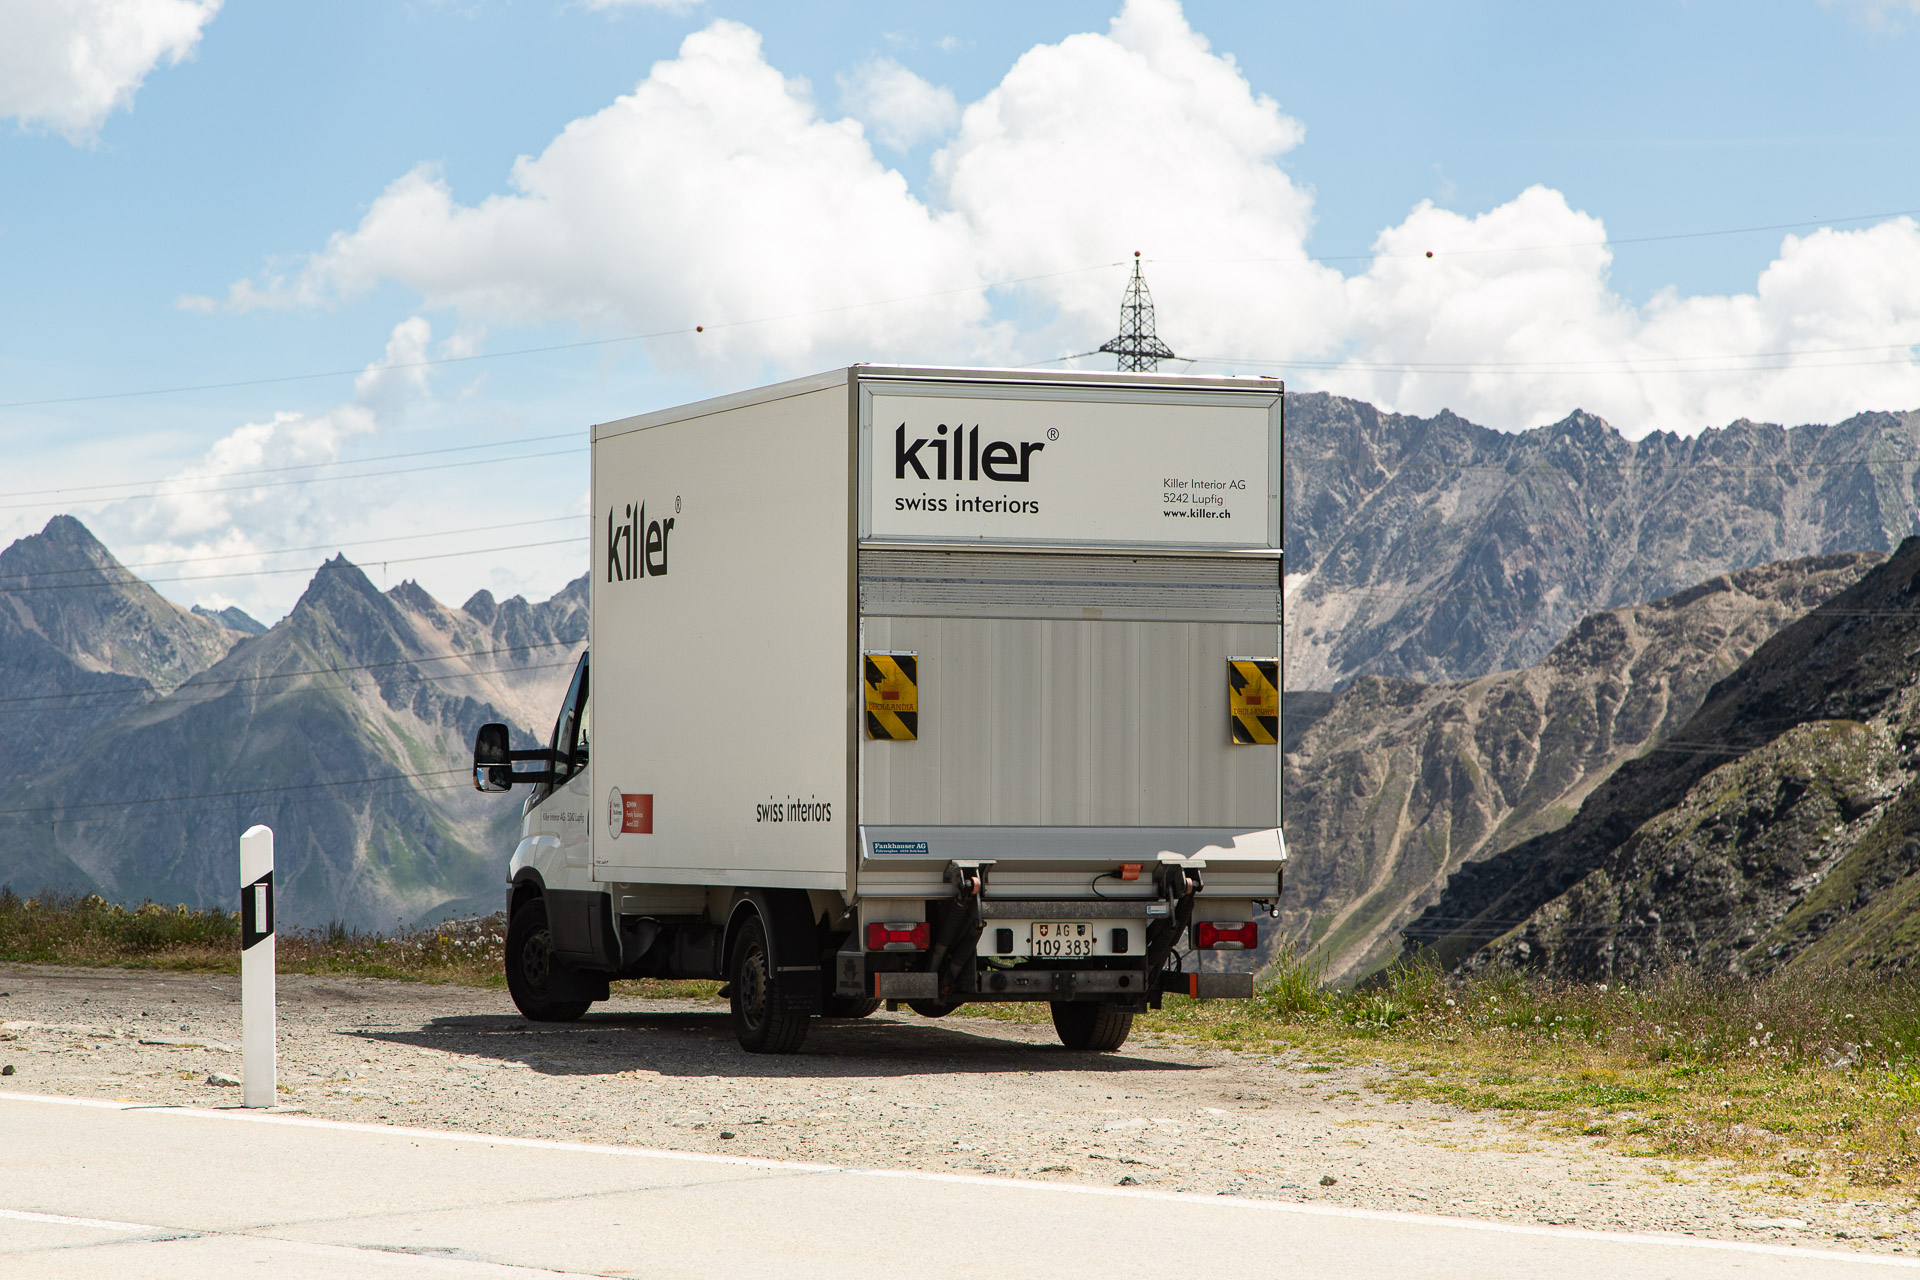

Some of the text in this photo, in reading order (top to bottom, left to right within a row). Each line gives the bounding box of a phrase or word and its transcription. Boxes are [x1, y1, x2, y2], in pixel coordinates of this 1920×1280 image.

[1163, 478, 1246, 490] Killer Interior AG
[895, 492, 1040, 514] swiss interiors
[1163, 492, 1224, 507] 5242 Lupfig
[1163, 508, 1231, 519] www.killer.ch
[868, 703, 915, 711] DHOLLANDIA
[756, 793, 832, 823] swiss interiors
[1056, 924, 1070, 937] AG
[1036, 939, 1091, 956] 109 383
